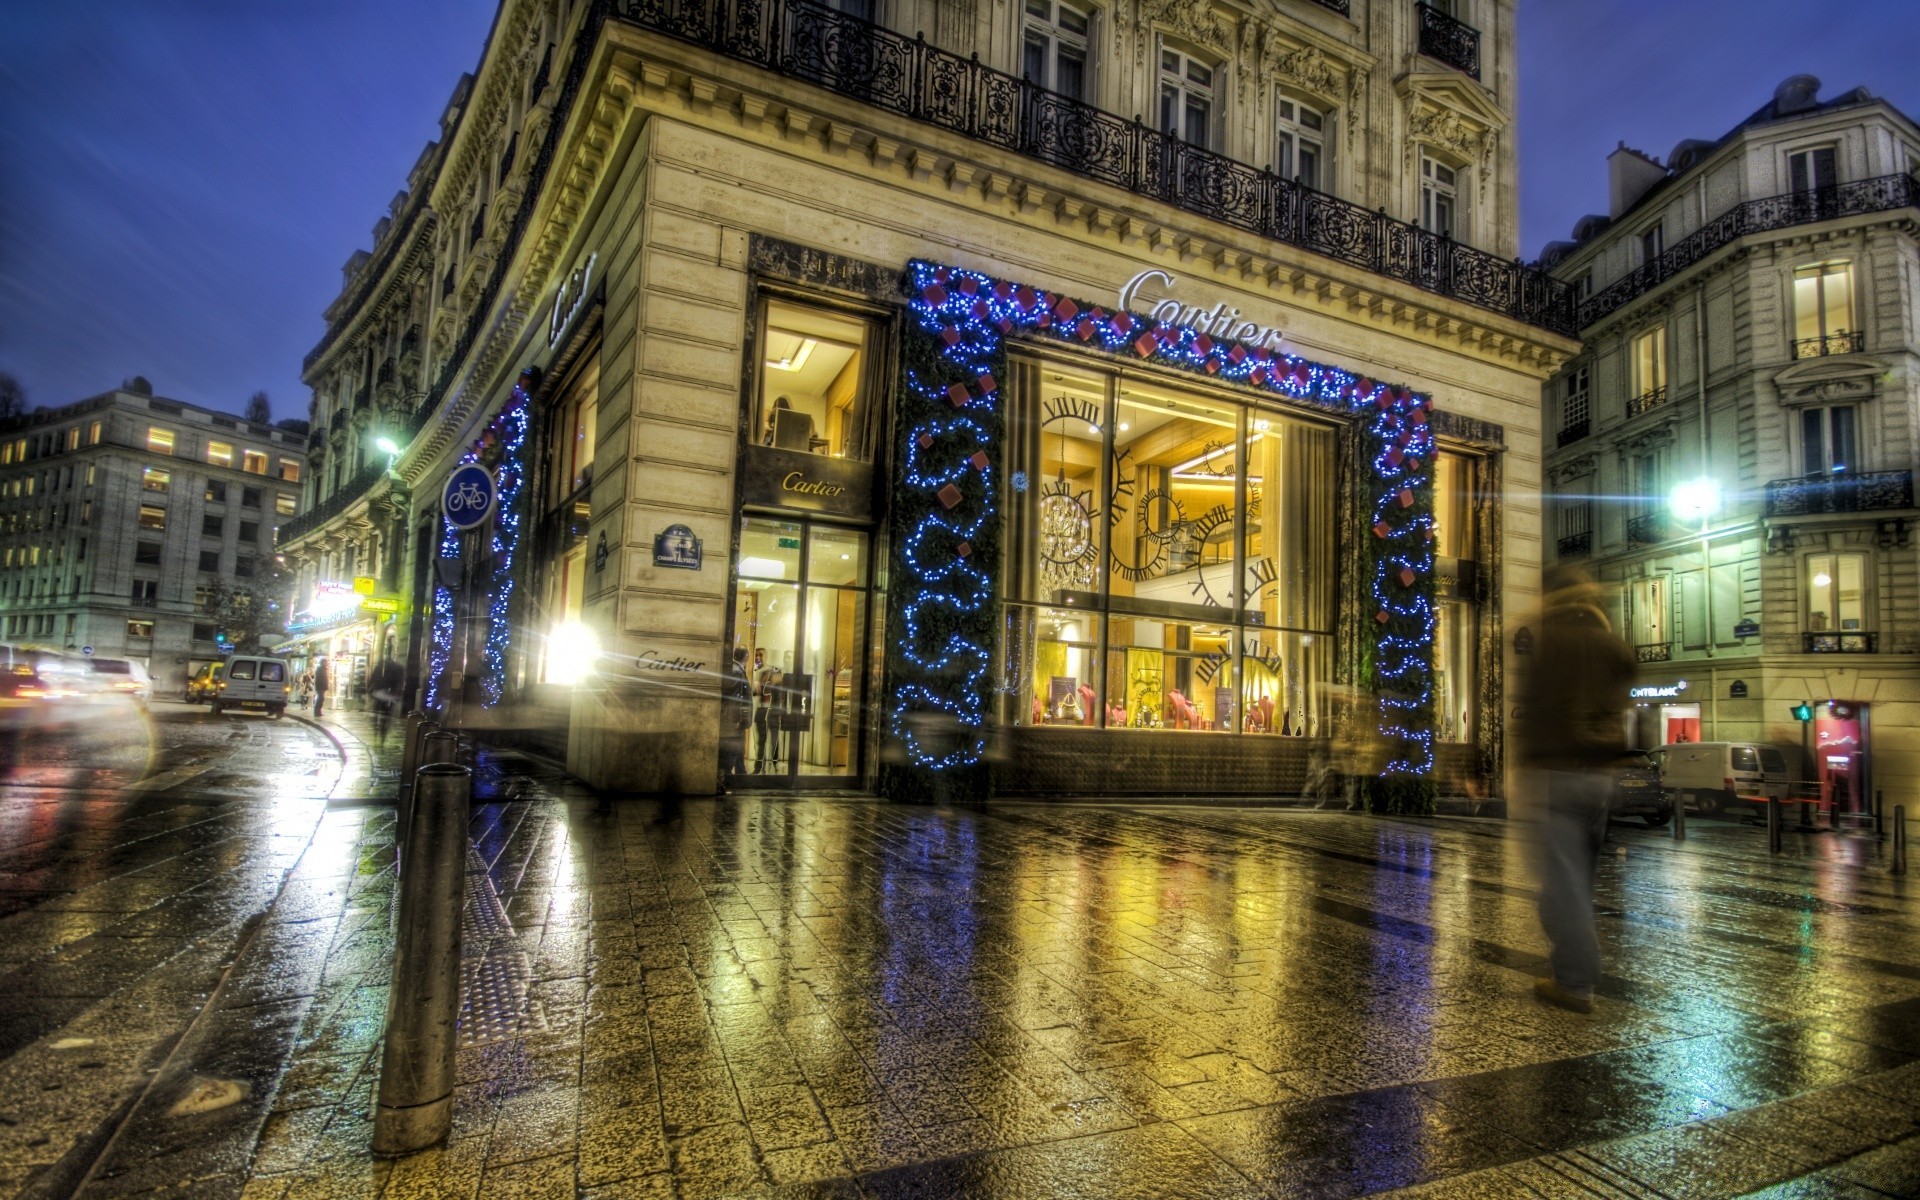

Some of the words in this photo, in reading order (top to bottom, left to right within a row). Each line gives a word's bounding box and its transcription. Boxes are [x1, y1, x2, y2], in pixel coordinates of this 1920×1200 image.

[1118, 269, 1283, 349] Cartier
[782, 471, 846, 497] Cartier
[635, 650, 706, 673] Cartier
[1629, 686, 1680, 698] ONTBLANC
